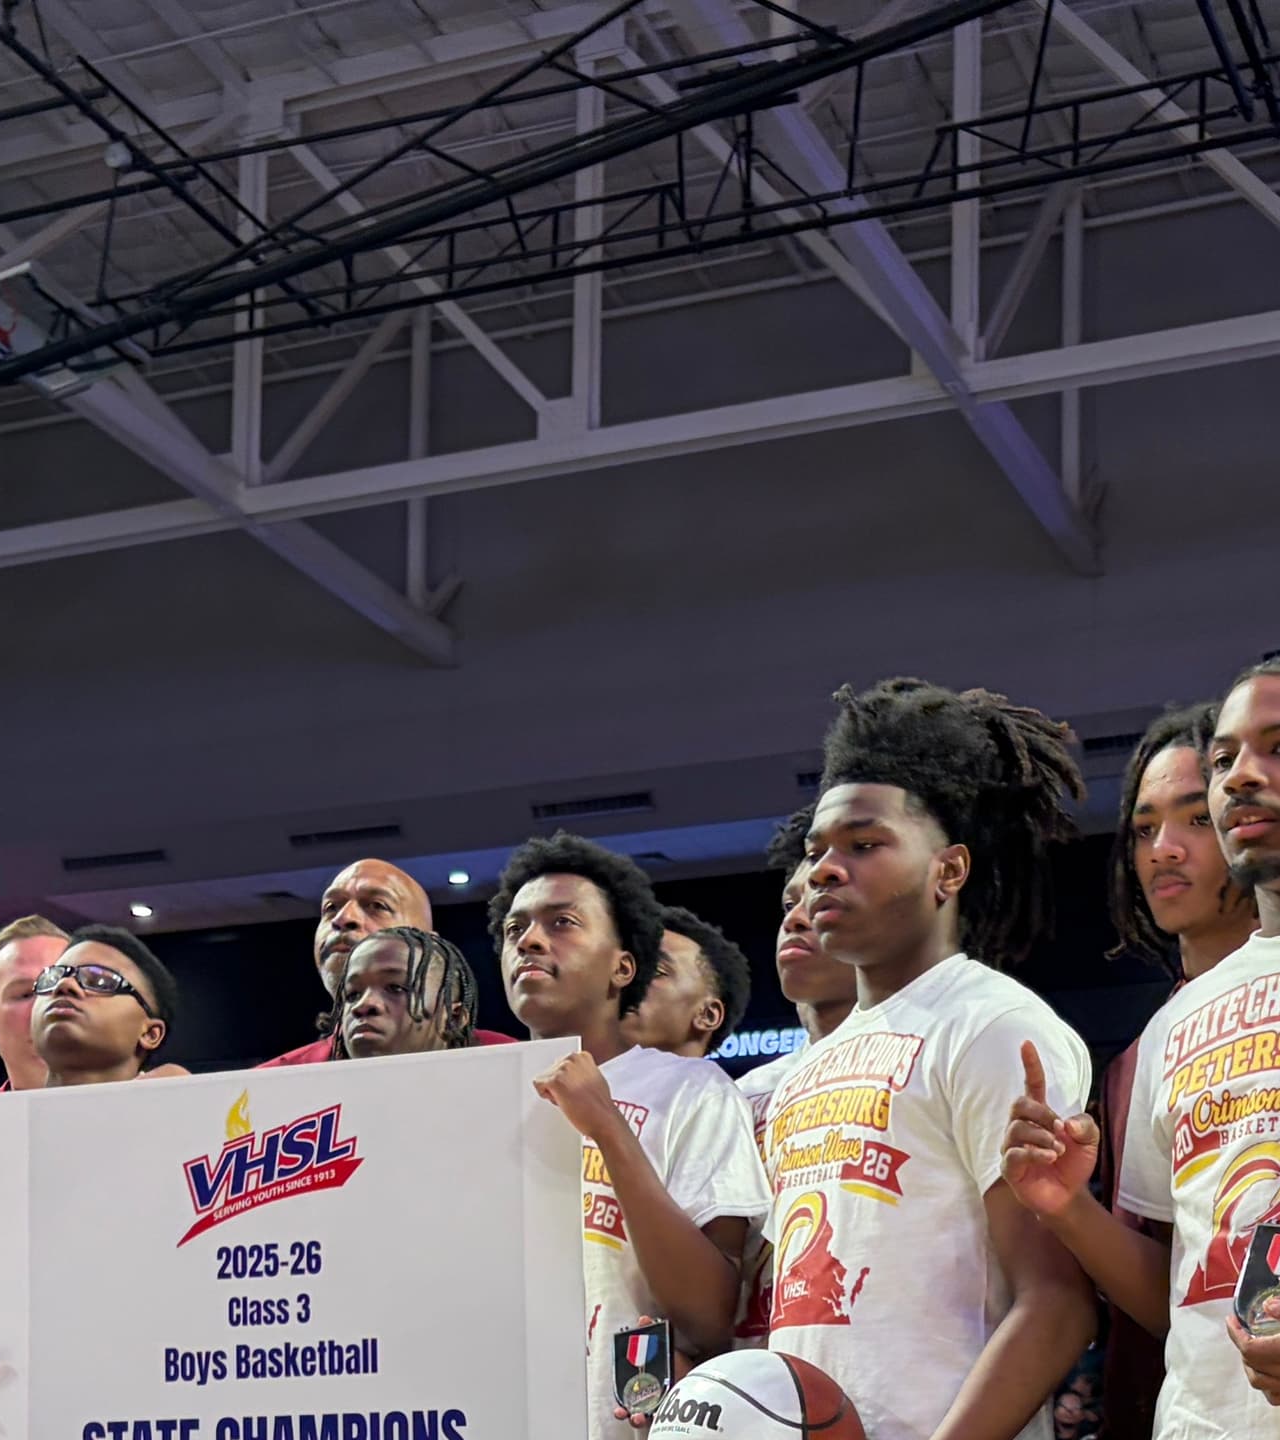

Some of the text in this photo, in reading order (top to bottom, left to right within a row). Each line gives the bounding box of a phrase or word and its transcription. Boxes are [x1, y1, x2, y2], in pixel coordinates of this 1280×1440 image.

[1163, 983, 1248, 1081] STATE
[184, 1104, 357, 1213] VHSL
[822, 1127, 863, 1165] Wave
[863, 1147, 893, 1182] 26
[212, 1168, 337, 1222] SERVING YOUTH SINCE 1913
[592, 1200, 618, 1229] 26
[216, 1240, 322, 1280] 2025-26
[228, 1292, 311, 1327] Class 3
[783, 1279, 809, 1300] VHSL
[164, 1338, 379, 1386] Boys Basketball
[654, 1387, 722, 1431] lson
